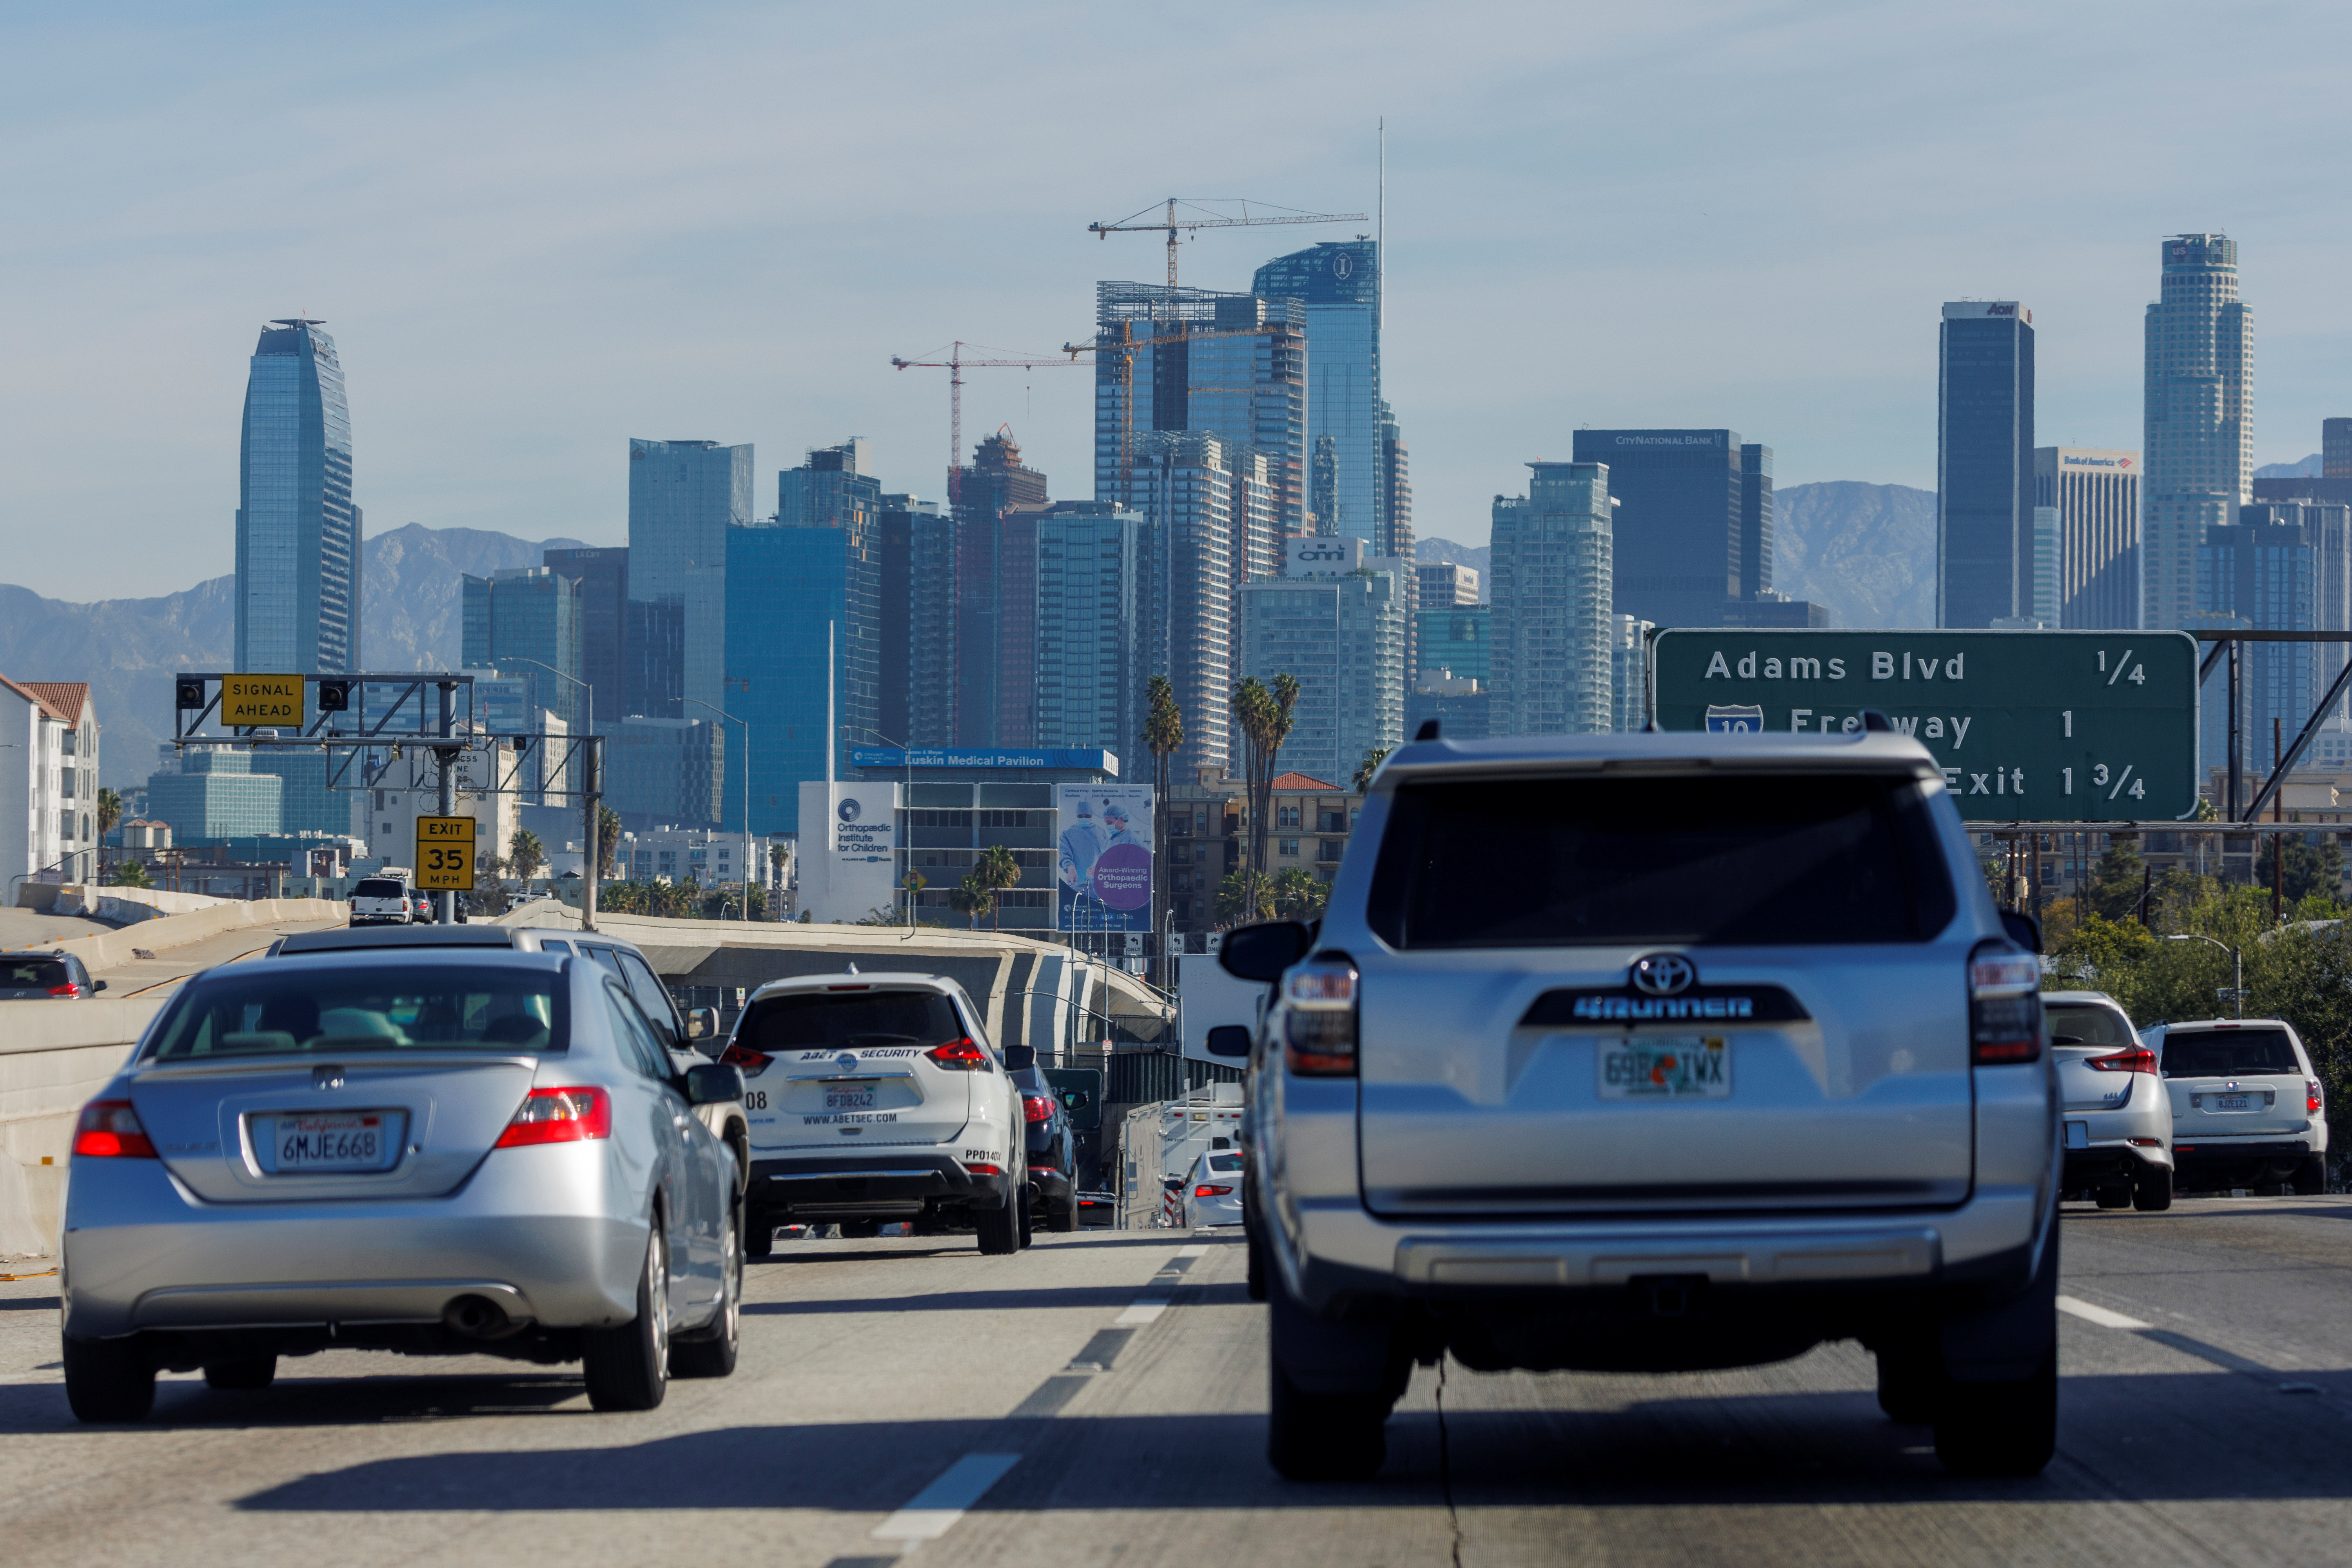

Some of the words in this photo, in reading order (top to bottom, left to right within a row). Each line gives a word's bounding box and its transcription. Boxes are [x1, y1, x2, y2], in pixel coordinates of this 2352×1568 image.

[1685, 436, 1712, 445] BANK
[2065, 456, 2081, 464] Bank
[2088, 457, 2114, 466] America
[1704, 651, 1846, 679] Adams
[1872, 652, 1963, 680] Blvd
[2097, 650, 2145, 685] 1/4
[232, 684, 294, 695] SIGNAL
[234, 704, 291, 716] AHEAD
[1722, 721, 1748, 734] 10
[1791, 709, 1971, 749] Freway
[2062, 710, 2071, 737] 1
[905, 755, 944, 765] Luskin
[948, 755, 993, 766] Medical
[998, 755, 1044, 766] Pavilion
[1941, 766, 2024, 795] Exit
[2062, 768, 2071, 795] 1
[2093, 764, 2145, 800] 3/4
[429, 824, 462, 835] EXIT
[838, 834, 873, 842] Institute
[837, 844, 849, 852] for
[851, 844, 888, 852] Children
[427, 849, 463, 870] 35
[430, 875, 459, 884] MPH
[1098, 873, 1148, 882] Orthopaedic
[1103, 881, 1142, 890] Surgeons
[800, 1050, 838, 1061] ABET
[860, 1049, 921, 1059] SECURITY
[746, 1091, 767, 1111] 08
[827, 1094, 873, 1107] 8FDB242
[2218, 1100, 2248, 1109] 8JZE121
[298, 1117, 357, 1133] California
[803, 1113, 897, 1125] WWW.ABETSEC.COM
[283, 1131, 376, 1161] 6MJE668
